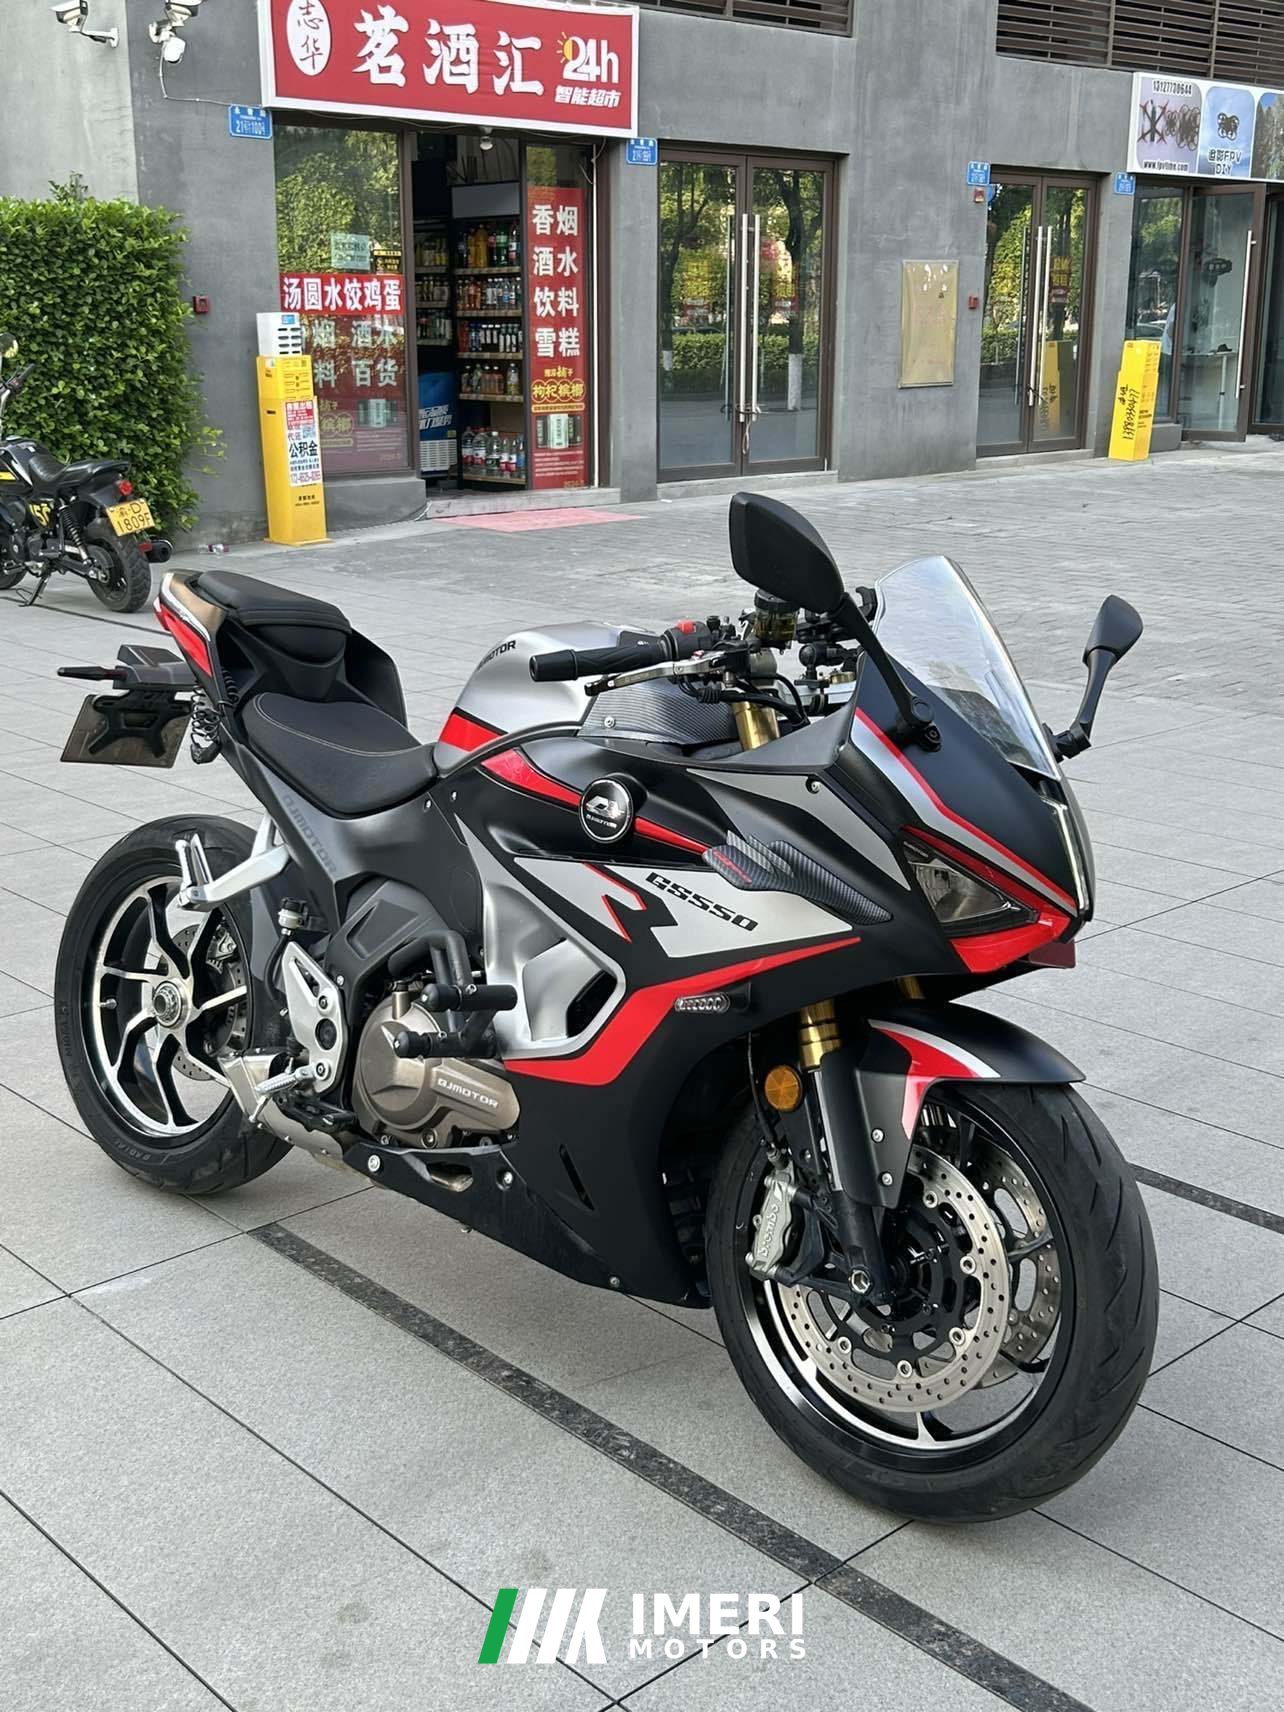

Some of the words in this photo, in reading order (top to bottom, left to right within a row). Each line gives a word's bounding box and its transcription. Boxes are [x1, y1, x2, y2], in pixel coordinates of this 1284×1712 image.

[352, 5, 545, 96] 茗酒汇
[562, 36, 619, 84] 24h
[555, 85, 621, 108] 智能超市
[532, 204, 578, 236] 香烟
[532, 246, 579, 277] 酒水
[283, 277, 402, 311] 汤圆水饺鸡蛋
[533, 287, 579, 317] 饮料
[535, 327, 581, 358] 雪糕
[289, 440, 318, 458] 公积金
[437, 1078, 499, 1109] QJMOTOR
